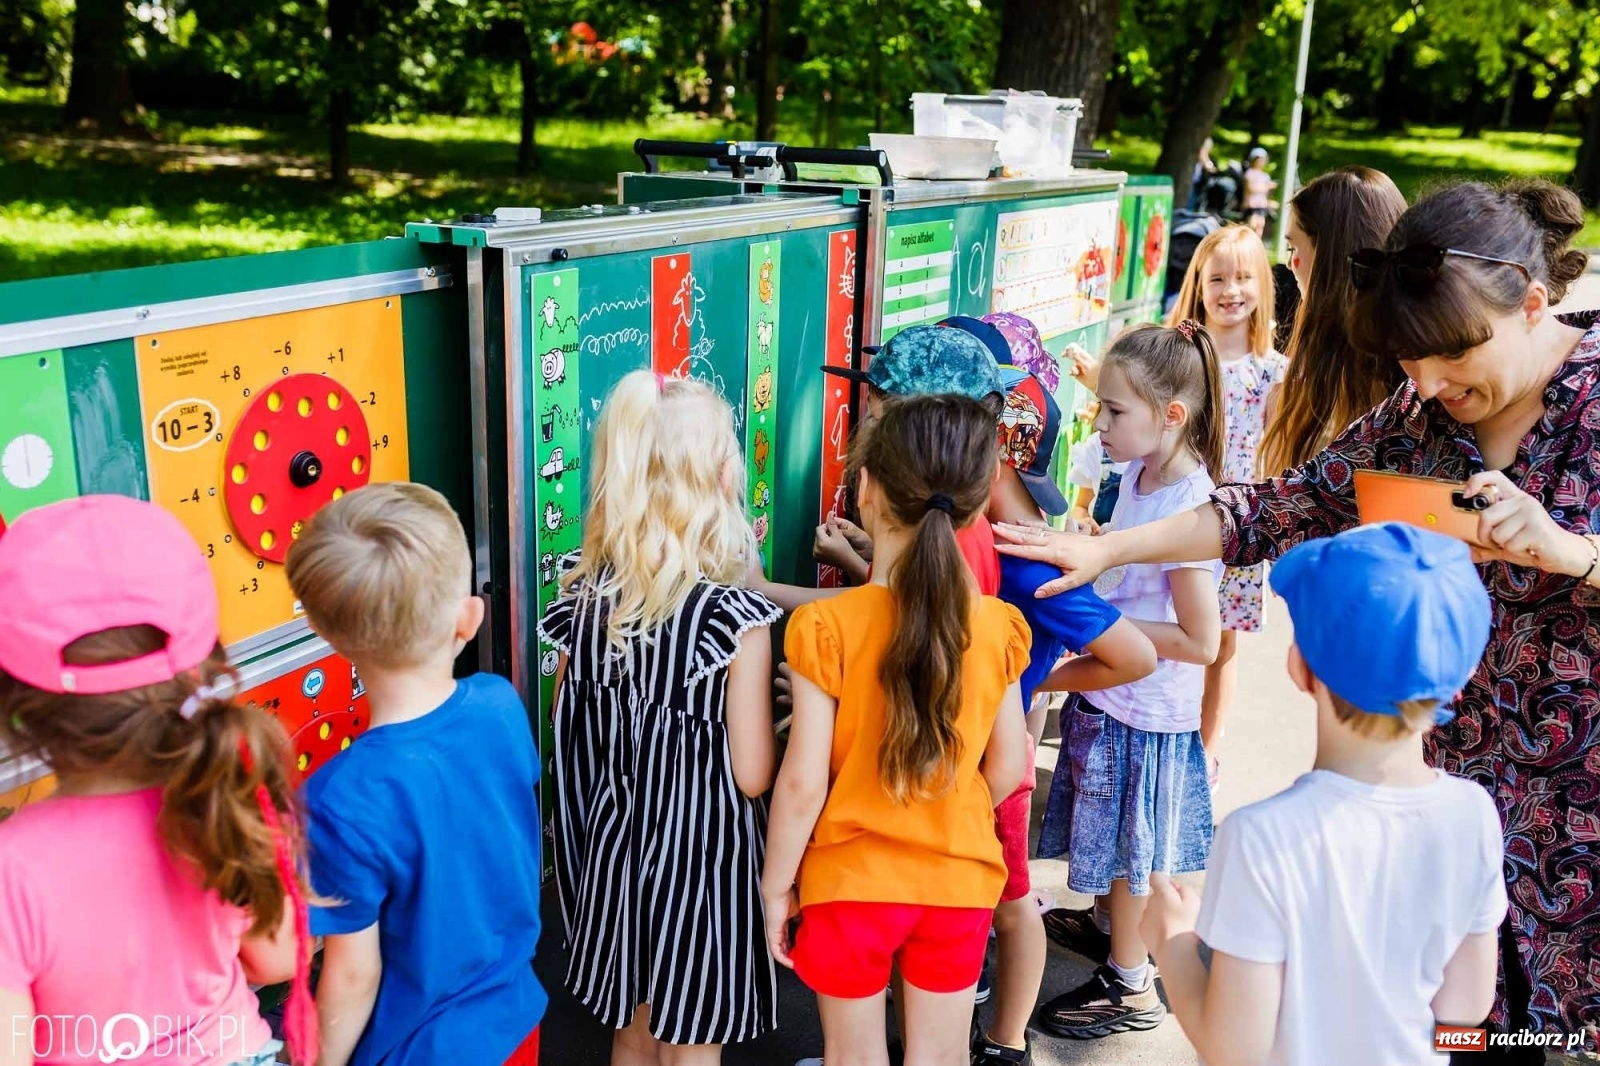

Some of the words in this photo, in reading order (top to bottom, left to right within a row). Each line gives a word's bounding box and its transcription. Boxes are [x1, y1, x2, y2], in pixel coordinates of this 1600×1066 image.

[900, 233, 917, 248] napisz
[917, 231, 935, 244] alfabet
[180, 405, 199, 416] START
